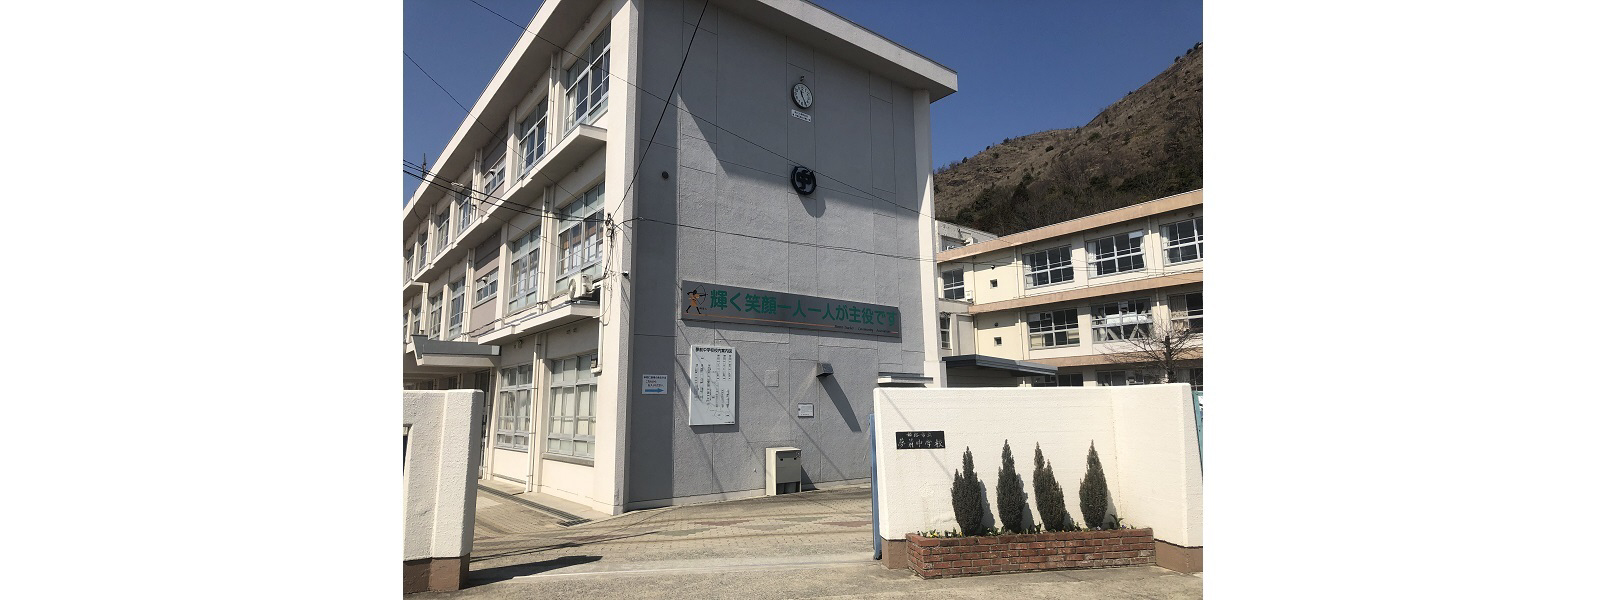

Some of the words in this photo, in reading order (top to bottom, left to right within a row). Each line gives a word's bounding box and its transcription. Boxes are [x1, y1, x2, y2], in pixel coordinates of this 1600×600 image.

[710, 290, 897, 326] 輝く笑顔一人一人が主役です
